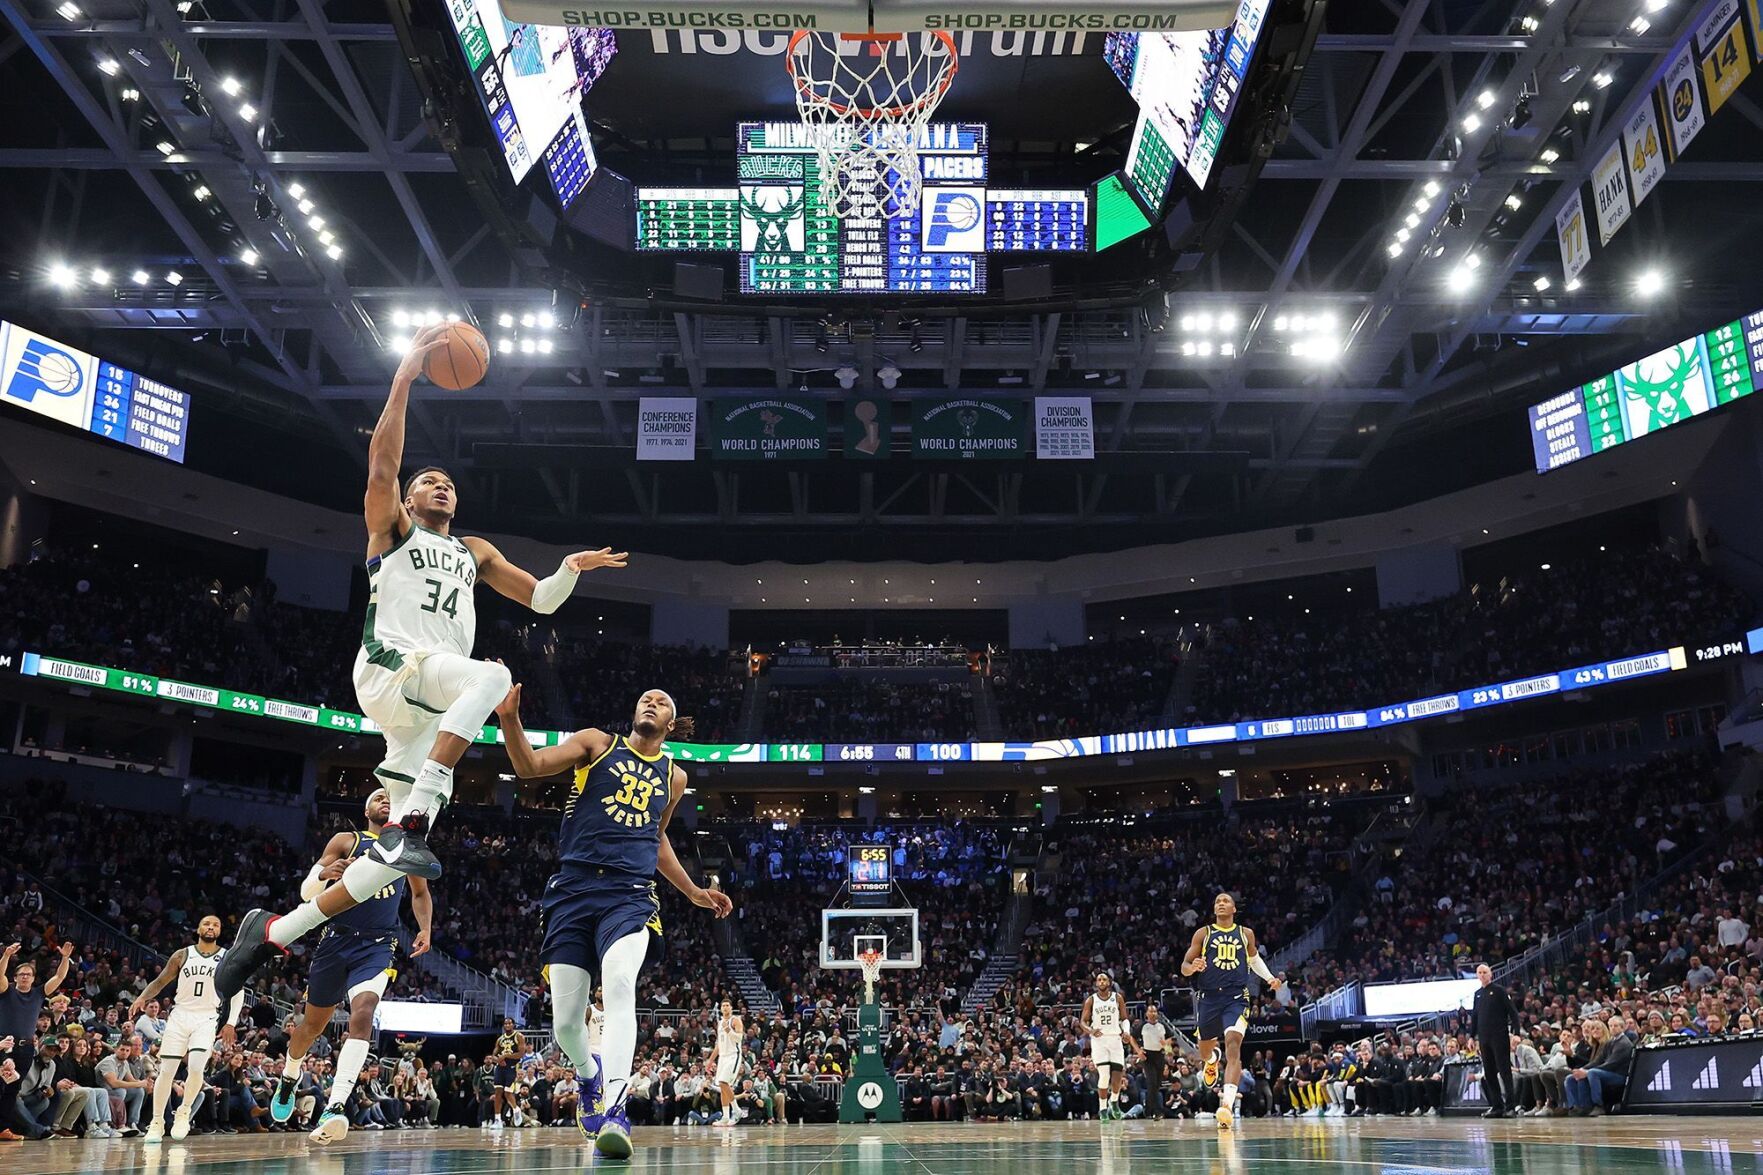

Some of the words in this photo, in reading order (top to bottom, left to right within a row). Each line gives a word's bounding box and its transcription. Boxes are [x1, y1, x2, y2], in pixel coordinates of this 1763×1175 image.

[562, 10, 817, 28] SHOP.BUCKS.COM
[925, 14, 1177, 29] SHOP.BUCKS.COM
[1711, 32, 1738, 83] 14
[1674, 81, 1692, 119] 24
[1632, 123, 1658, 174] 44
[740, 155, 803, 178] BUCKS
[924, 157, 984, 179] PACERS
[1599, 168, 1624, 214] HANK
[1013, 203, 1024, 211] 22
[1053, 203, 1059, 211] 7
[847, 231, 862, 240] TOTAL
[1561, 211, 1582, 264] 77
[687, 240, 697, 248] 13
[1012, 241, 1023, 249] 22
[844, 255, 861, 265] FIELD
[1715, 326, 1733, 342] 12
[1717, 340, 1735, 356] 17
[1720, 355, 1737, 371] 41
[108, 366, 124, 381] 15
[1723, 370, 1741, 385] 26
[106, 380, 122, 395] 13
[138, 377, 183, 404] TURNOVERS
[1591, 378, 1607, 393] 37
[1729, 386, 1739, 399] 6
[103, 394, 120, 410] 36
[134, 390, 150, 406] FAST
[1595, 393, 1610, 407] 11
[102, 409, 118, 424] 21
[134, 405, 154, 422] FIELD
[156, 413, 181, 432] GOALS
[642, 411, 694, 422] CONFERENCE
[725, 405, 750, 422] NATIONAL
[749, 400, 782, 410] BASKETBALL
[923, 405, 946, 422] NATIONAL
[946, 399, 979, 409] BASKETBALL
[980, 401, 1013, 422] ASSOCIATION
[1047, 406, 1081, 417] DIVISION
[1599, 407, 1609, 420] 6
[103, 424, 113, 437] 7
[643, 422, 691, 434] CHAMPIONS
[1041, 417, 1088, 428] CHAMPIONS
[1602, 420, 1611, 433] 6
[131, 418, 149, 435] FREE
[150, 426, 181, 446] THROWS
[140, 436, 169, 457] THREES
[674, 438, 687, 447] 2021
[721, 438, 757, 450] WORLD
[761, 438, 820, 450] CHAMPIONS
[920, 438, 955, 450] WORLD
[959, 438, 1018, 449] CHAMPIONS
[1549, 433, 1576, 454] STEALS
[408, 548, 475, 588] BUCKS
[420, 578, 459, 620] 34
[1695, 646, 1722, 662] 9:28
[1723, 641, 1743, 656] PM
[50, 662, 72, 677] FIELD
[74, 666, 101, 682] GOALS
[1612, 661, 1633, 676] FIELD
[1634, 657, 1659, 672] GOALS
[166, 684, 173, 696] 3
[175, 685, 213, 703] POINTERS
[1515, 679, 1551, 695] POINTERS
[267, 702, 284, 715] FREE
[284, 705, 314, 721] THROWS
[1412, 703, 1427, 716] FREE
[1428, 697, 1456, 712] THROWS
[1110, 728, 1178, 754] INDIANA
[779, 744, 811, 760] 114
[840, 745, 874, 760] 6:55
[895, 746, 911, 759] 4TH
[929, 744, 962, 760] 100
[608, 759, 665, 796] INDIANA
[614, 773, 654, 812] 33
[601, 795, 651, 828] PACERS
[861, 848, 887, 860] 6:55
[1218, 943, 1236, 961] 00
[183, 965, 215, 979] BUCK
[194, 981, 204, 997] 0
[1095, 1007, 1116, 1015] BUCKS
[1100, 1015, 1112, 1025] 22
